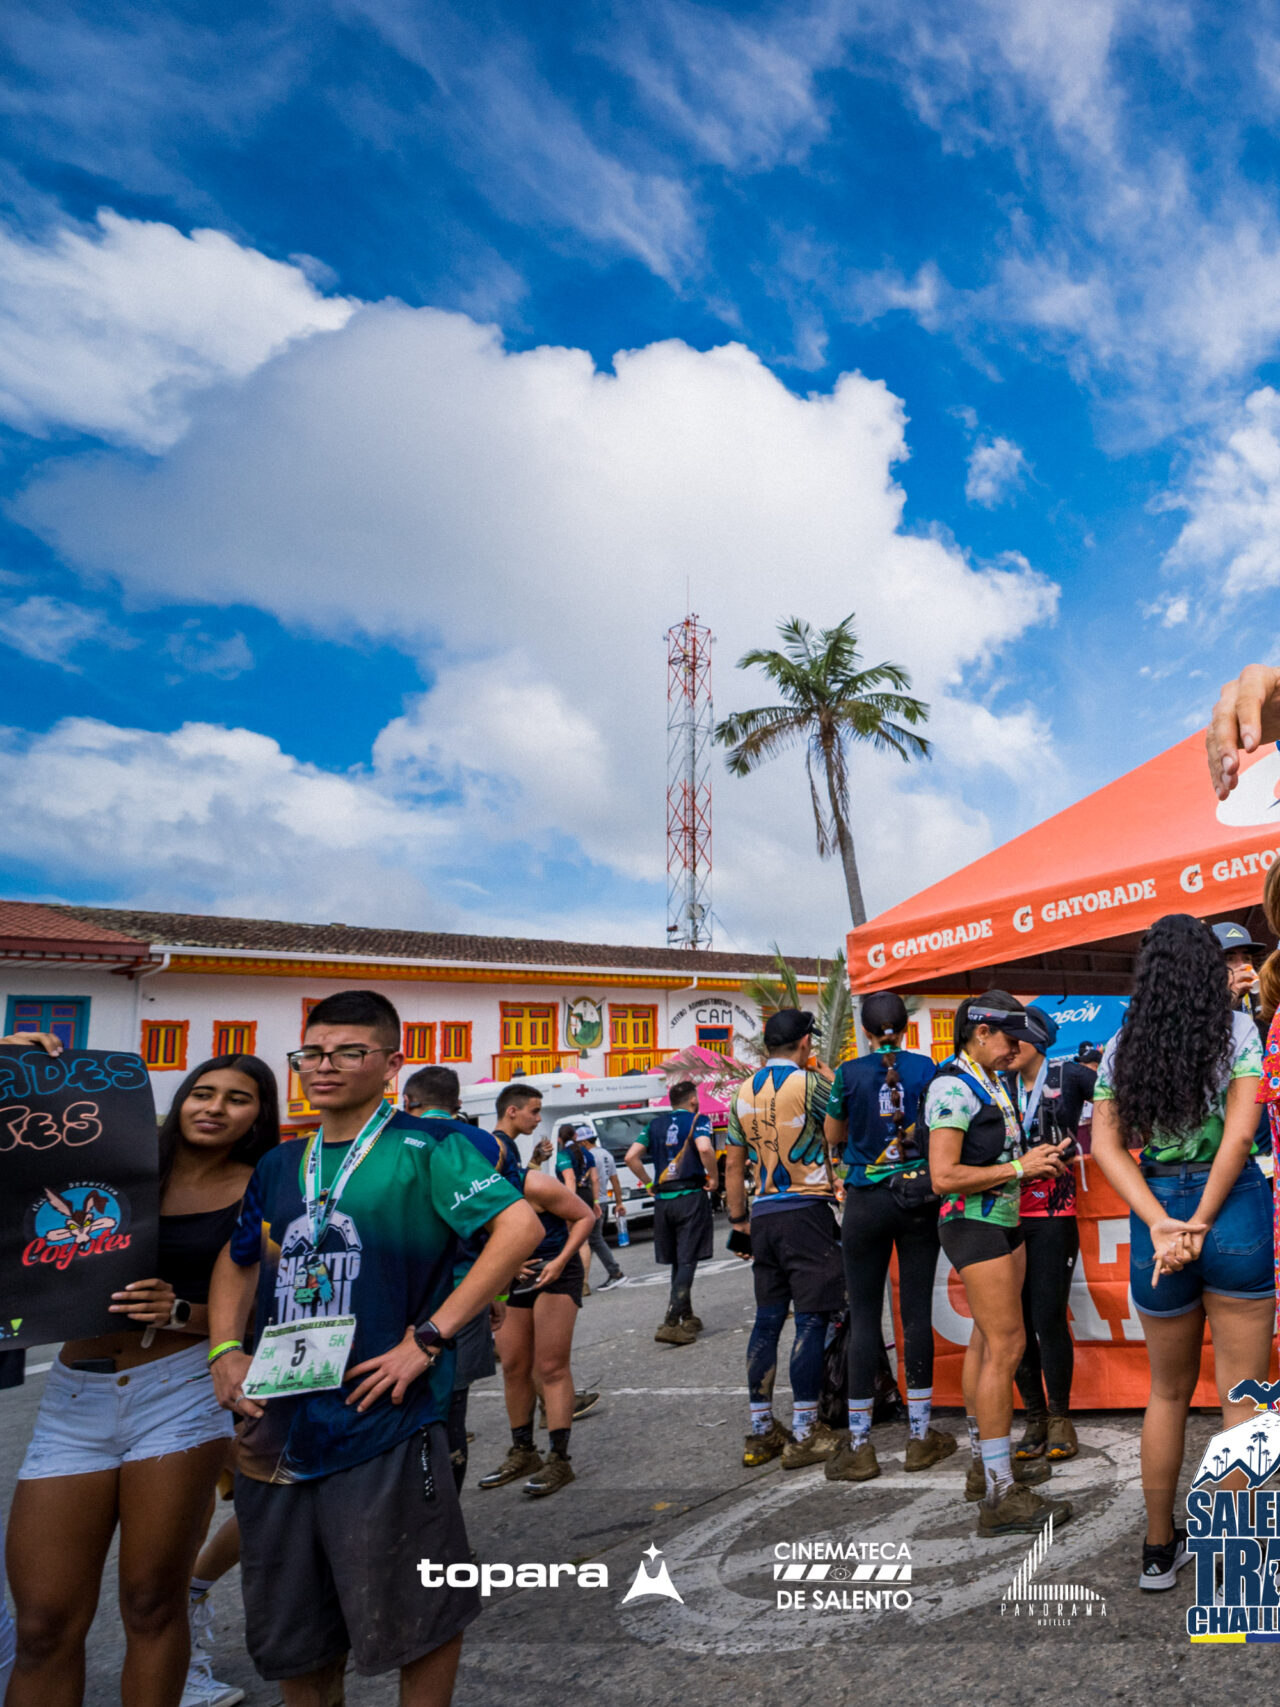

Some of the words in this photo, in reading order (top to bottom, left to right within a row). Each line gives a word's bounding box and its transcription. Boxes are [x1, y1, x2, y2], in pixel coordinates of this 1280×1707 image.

[1041, 878, 1157, 923] GATORADE
[891, 918, 993, 960] GATORADE
[695, 1008, 733, 1024] CAM
[22, 1228, 132, 1271] Coyotes
[290, 1338, 307, 1368] 5
